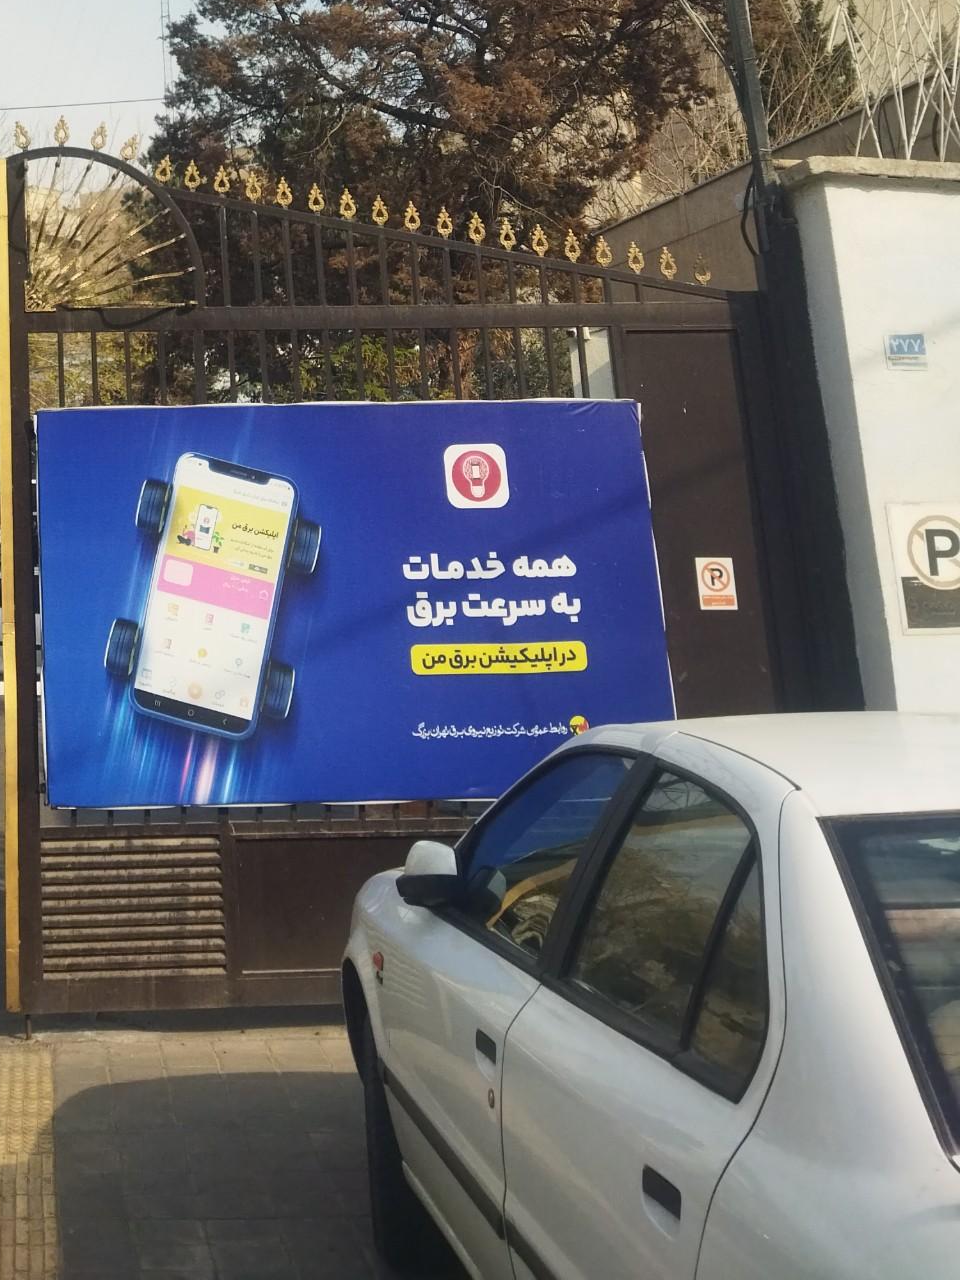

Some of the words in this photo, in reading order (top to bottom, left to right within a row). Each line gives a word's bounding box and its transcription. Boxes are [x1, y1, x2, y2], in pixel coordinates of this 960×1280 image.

[402, 551, 506, 580] خدمات
[512, 554, 577, 578] همه
[406, 591, 458, 627] برق
[461, 593, 546, 626] سرعت
[551, 592, 582, 623] به
[422, 652, 447, 669] من
[448, 649, 477, 669] برق
[479, 646, 558, 670] اپلیکیشن
[558, 648, 577, 666] در
[504, 721, 526, 737] شرکت
